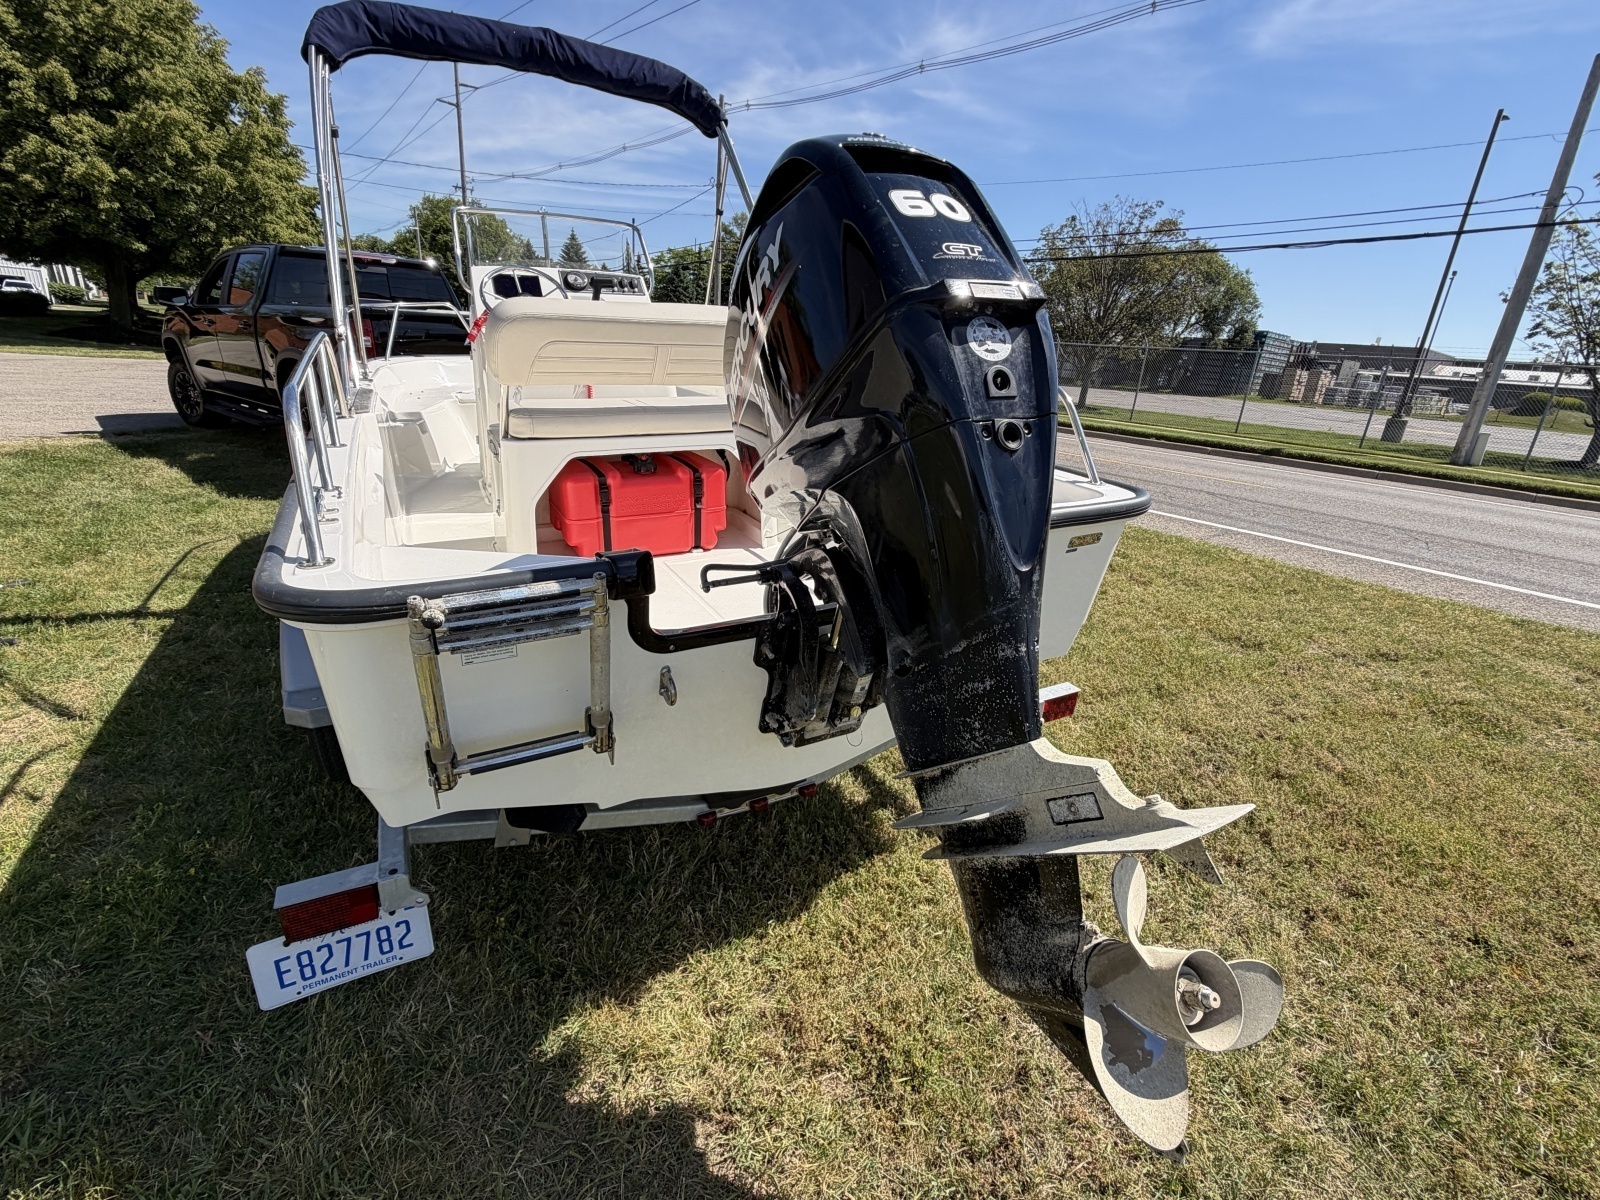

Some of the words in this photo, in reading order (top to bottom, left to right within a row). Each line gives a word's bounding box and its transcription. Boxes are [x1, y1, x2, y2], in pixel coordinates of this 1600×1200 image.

[888, 188, 972, 222] 60
[619, 495, 651, 504] DANGER
[620, 504, 652, 512] DANGER
[653, 501, 687, 509] ESSENCE
[273, 919, 414, 990] E827782
[302, 967, 358, 991] PERMANENT
[361, 954, 398, 972] TRAILER
